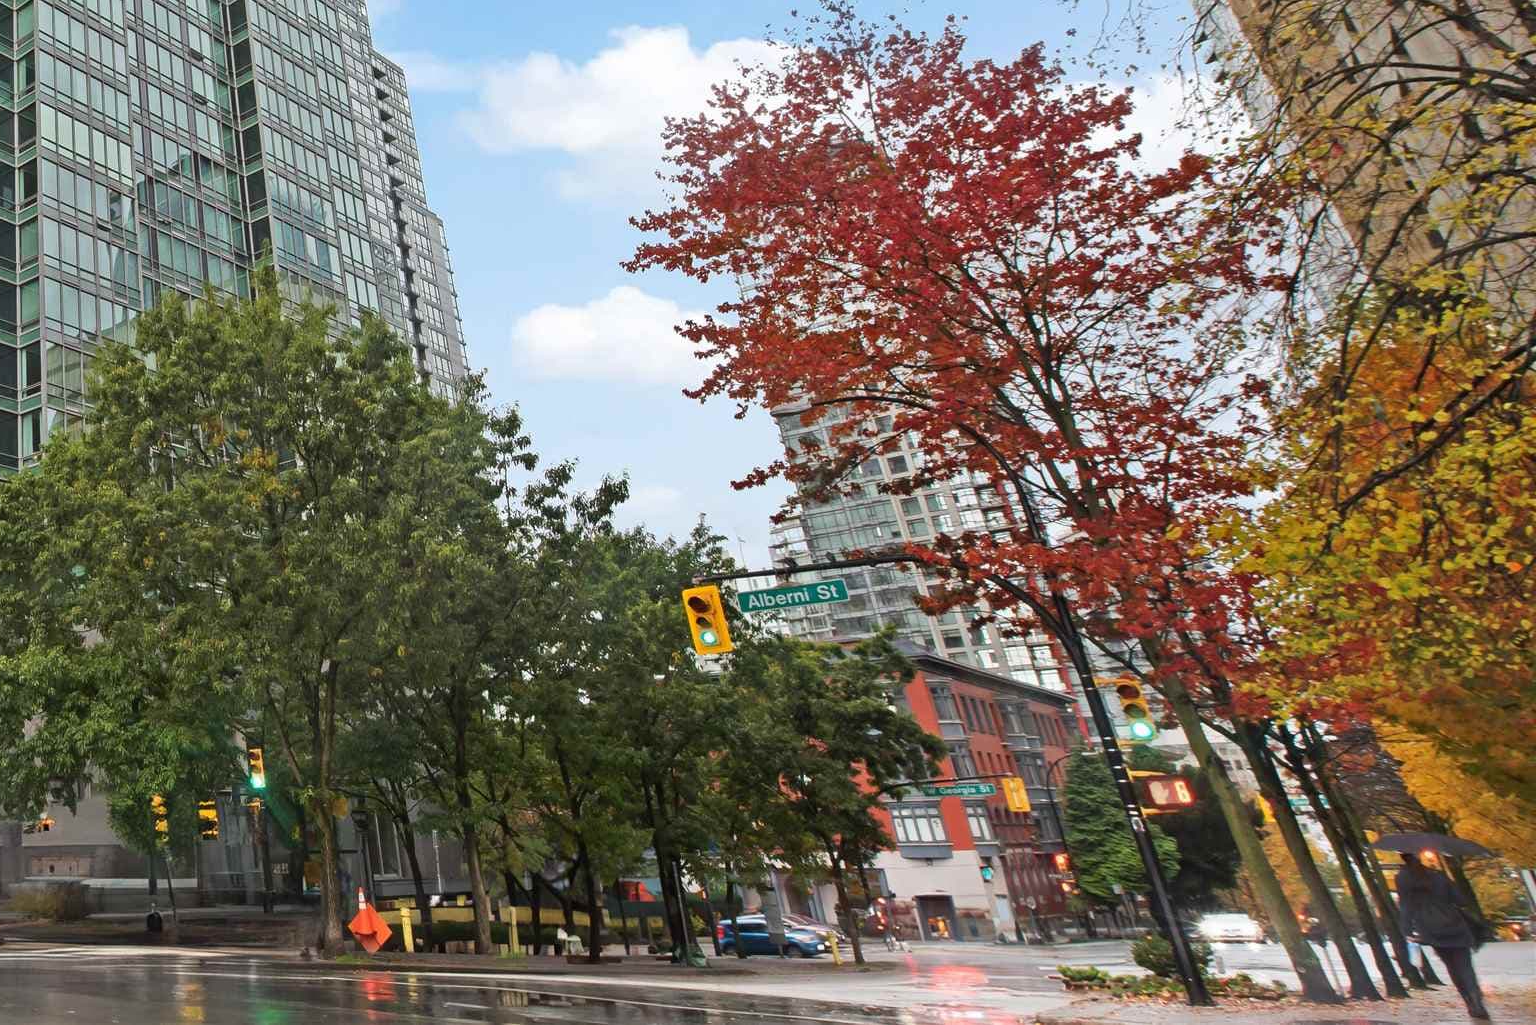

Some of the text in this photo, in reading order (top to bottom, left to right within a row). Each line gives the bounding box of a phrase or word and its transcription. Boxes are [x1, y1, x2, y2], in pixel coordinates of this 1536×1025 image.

[748, 584, 839, 609] Alberni St
[979, 785, 991, 793] St
